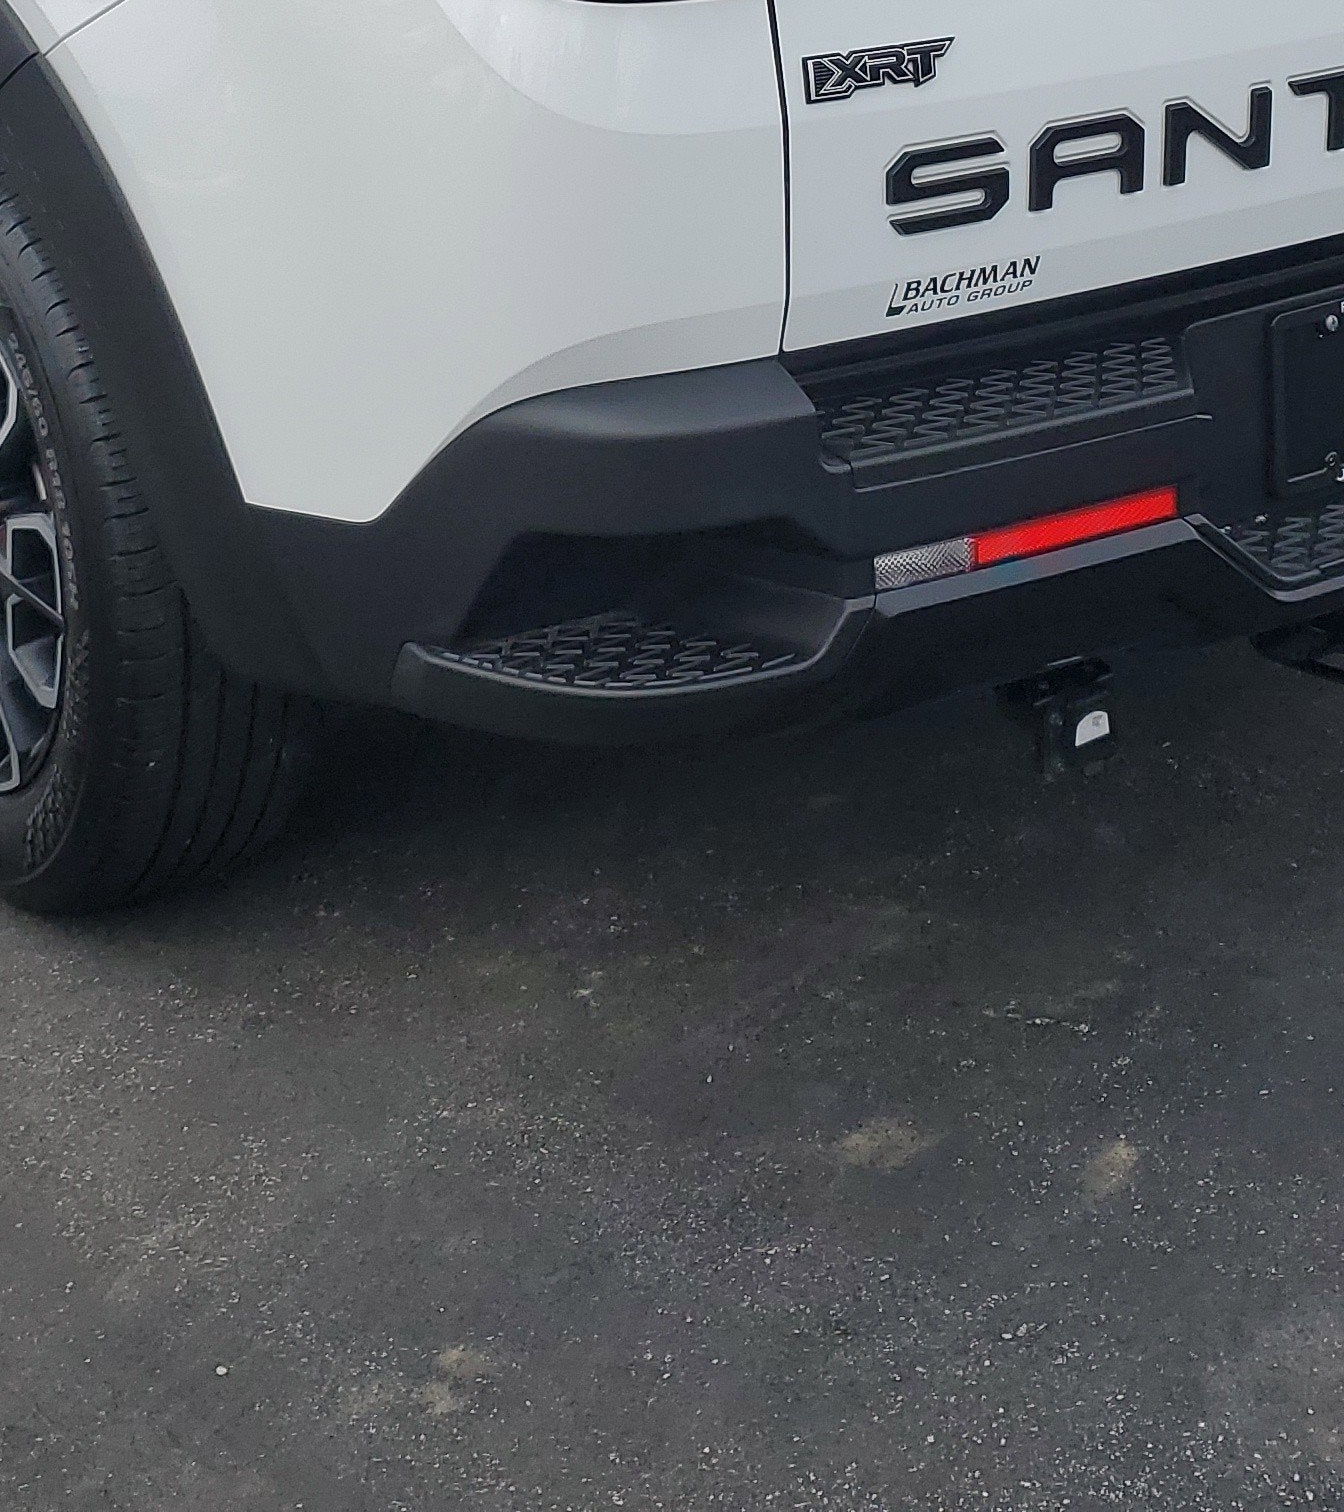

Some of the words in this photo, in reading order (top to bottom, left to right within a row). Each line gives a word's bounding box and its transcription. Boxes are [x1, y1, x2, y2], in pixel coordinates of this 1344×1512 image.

[802, 36, 955, 104] XRT
[902, 255, 1041, 302] BACHMAN
[906, 294, 960, 315] AUTO
[966, 279, 1034, 303] GROUP
